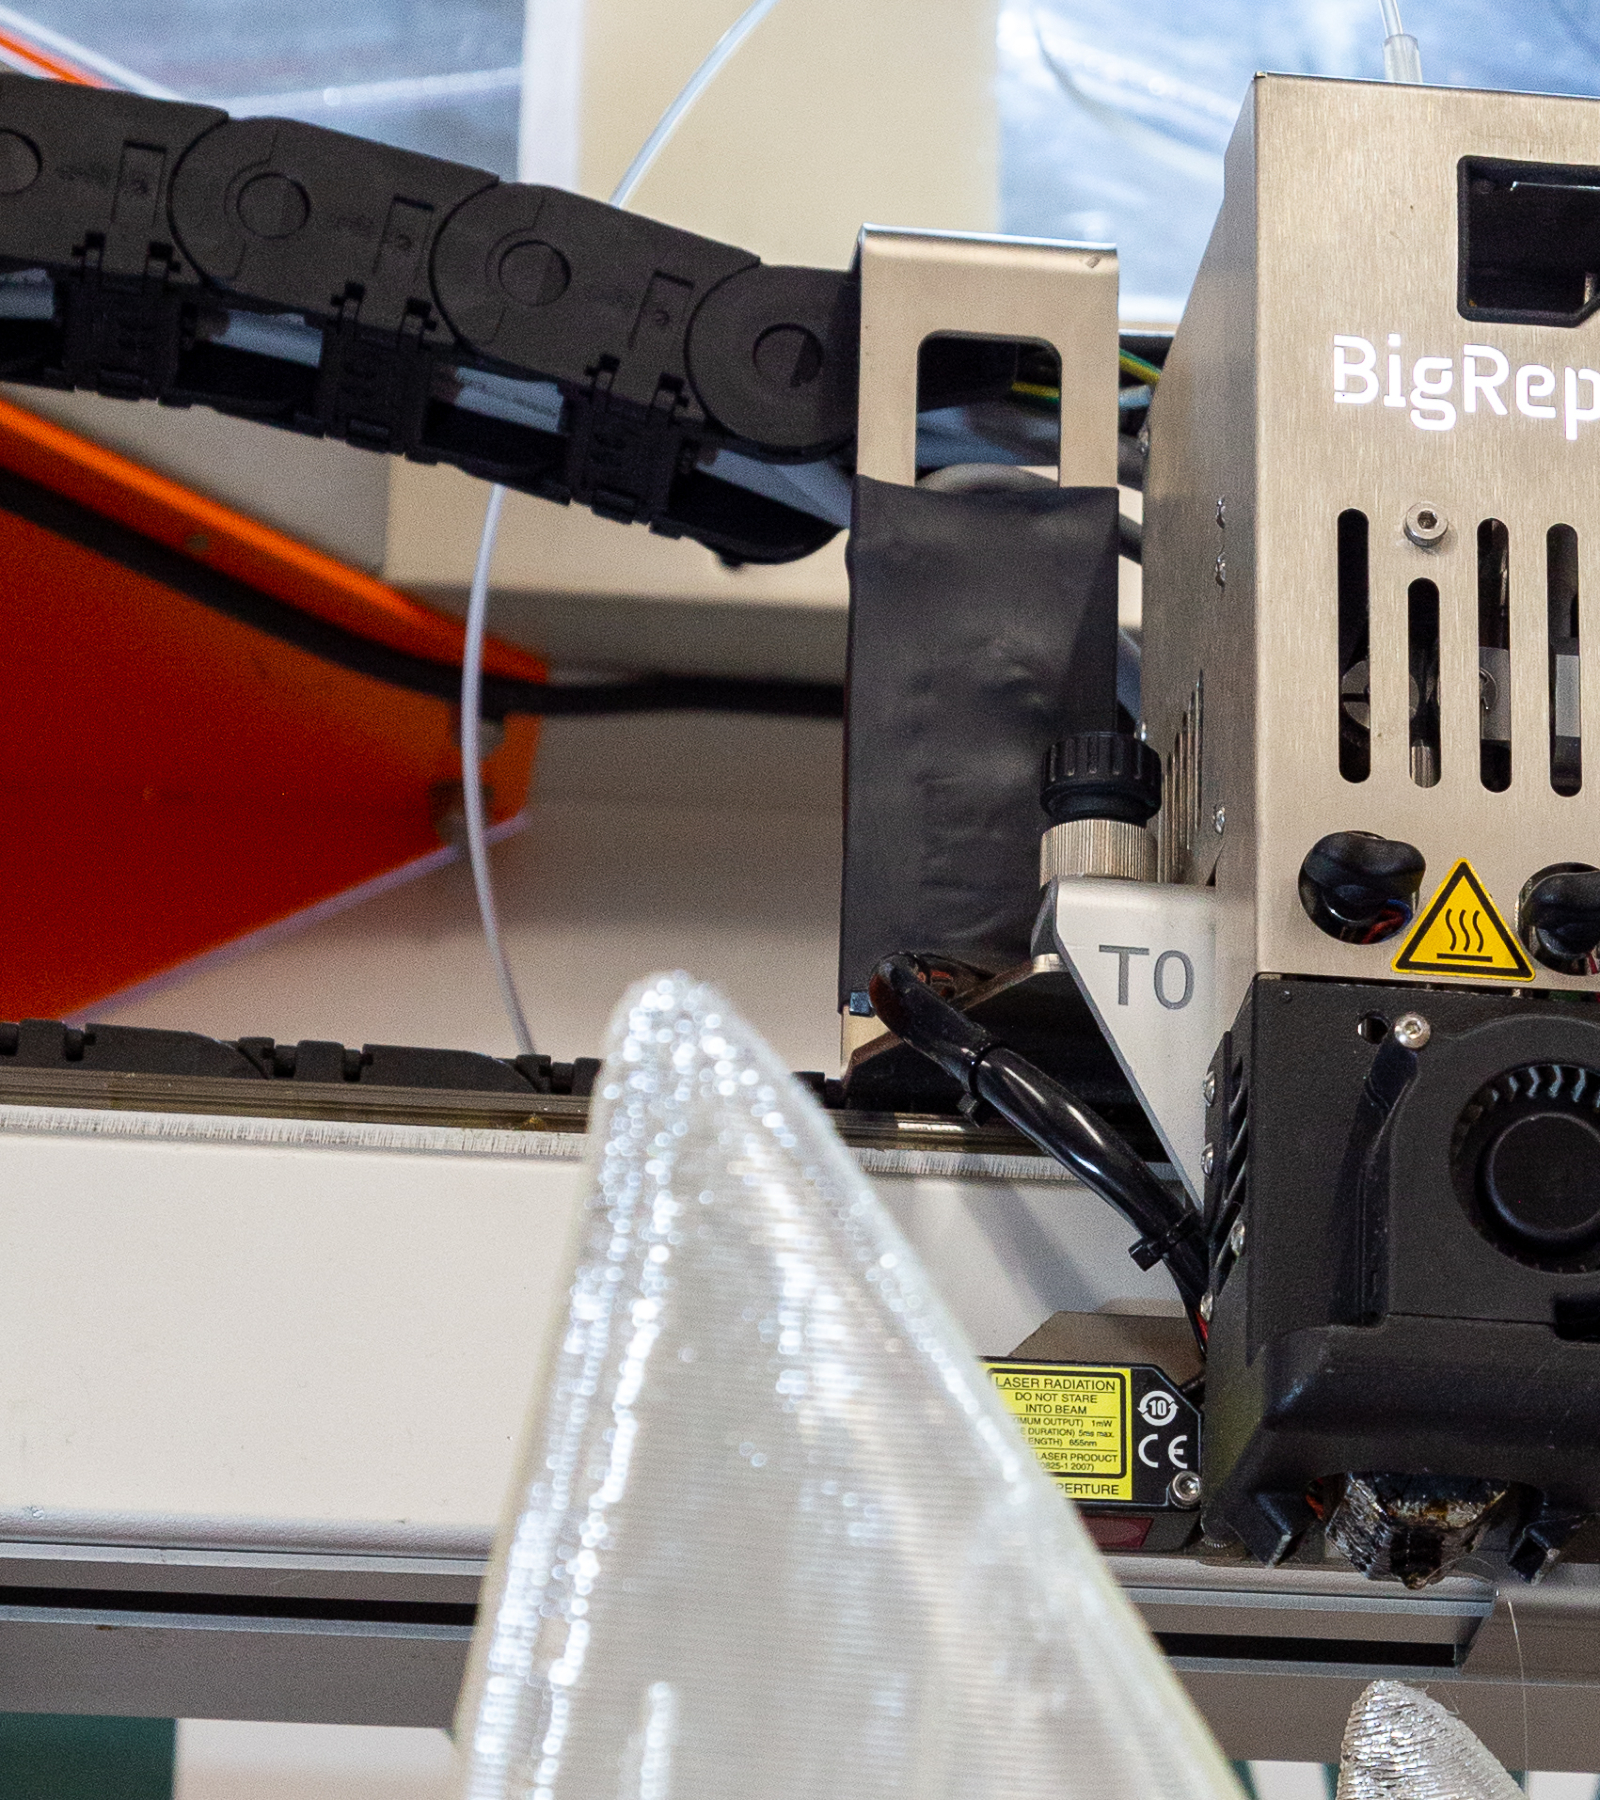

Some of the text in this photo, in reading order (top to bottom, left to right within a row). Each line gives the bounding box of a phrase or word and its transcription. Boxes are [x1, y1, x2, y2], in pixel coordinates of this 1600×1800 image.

[996, 1377, 1116, 1391] LASER RADIATION
[1015, 1392, 1098, 1404] DO NOT STARE
[1025, 1404, 1087, 1415] INTO BEAM
[1149, 1400, 1167, 1416] 10
[1043, 1417, 1084, 1427] OUTPUT)
[1091, 1419, 1113, 1427] 1mW
[1028, 1427, 1075, 1438] DURATION)
[1027, 1437, 1063, 1447] ENGTH)
[1036, 1452, 1118, 1462] LASER PRODUCT
[1056, 1483, 1119, 1495] PERTURE
